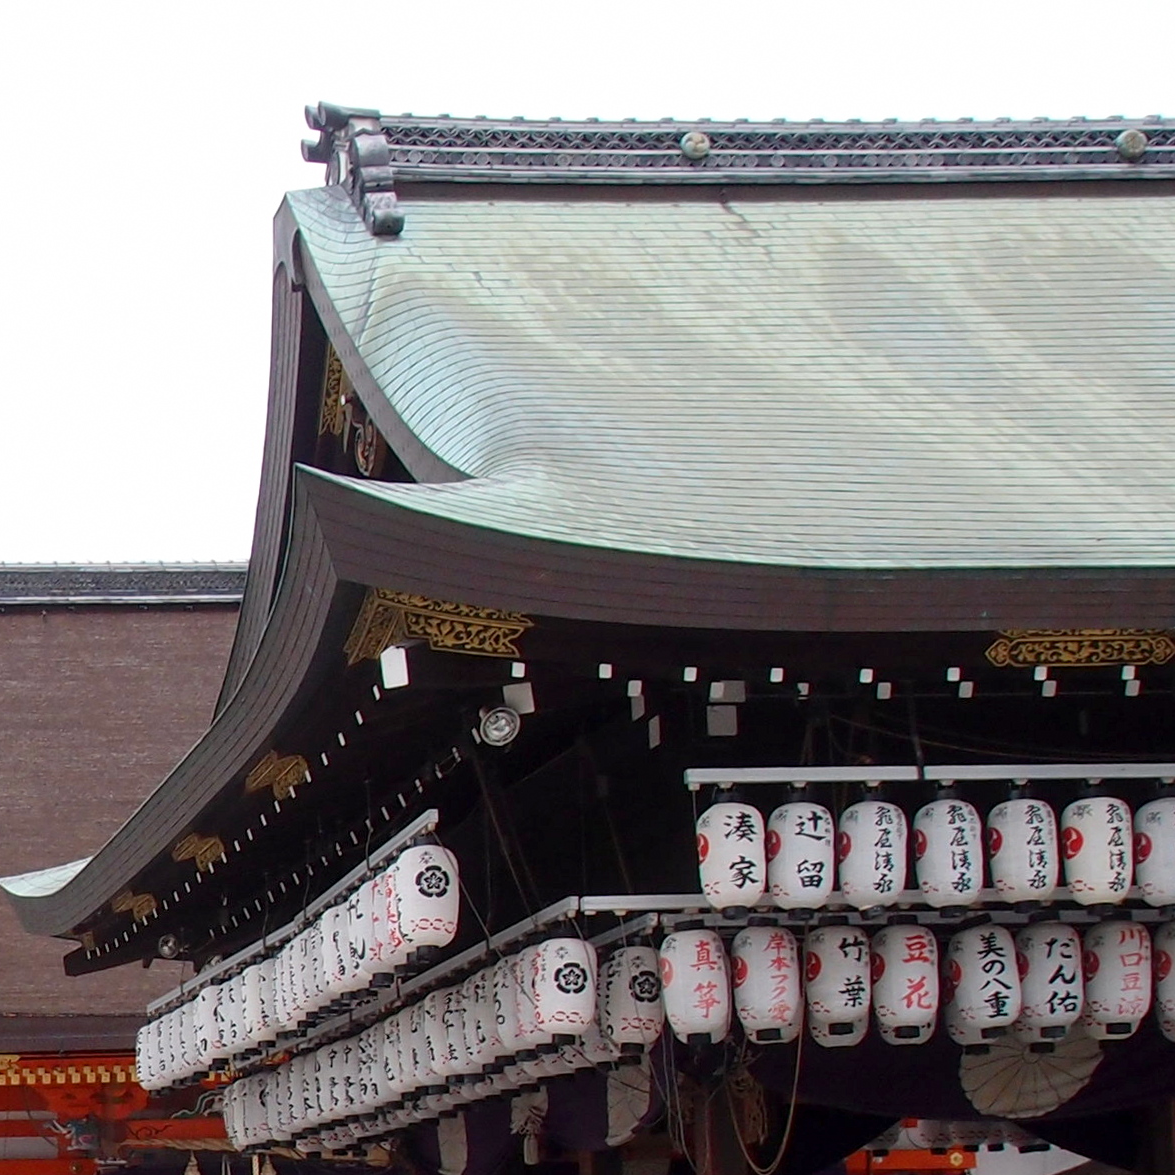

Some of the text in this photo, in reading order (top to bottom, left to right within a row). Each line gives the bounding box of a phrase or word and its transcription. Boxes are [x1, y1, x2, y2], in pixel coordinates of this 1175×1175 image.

[724, 811, 759, 889] 湊家
[794, 810, 826, 888] 辻留
[838, 935, 866, 1008] 竹葉
[902, 934, 933, 1010] 豆花
[977, 931, 1013, 1019] 美の八重
[1044, 937, 1078, 1015] だん佑
